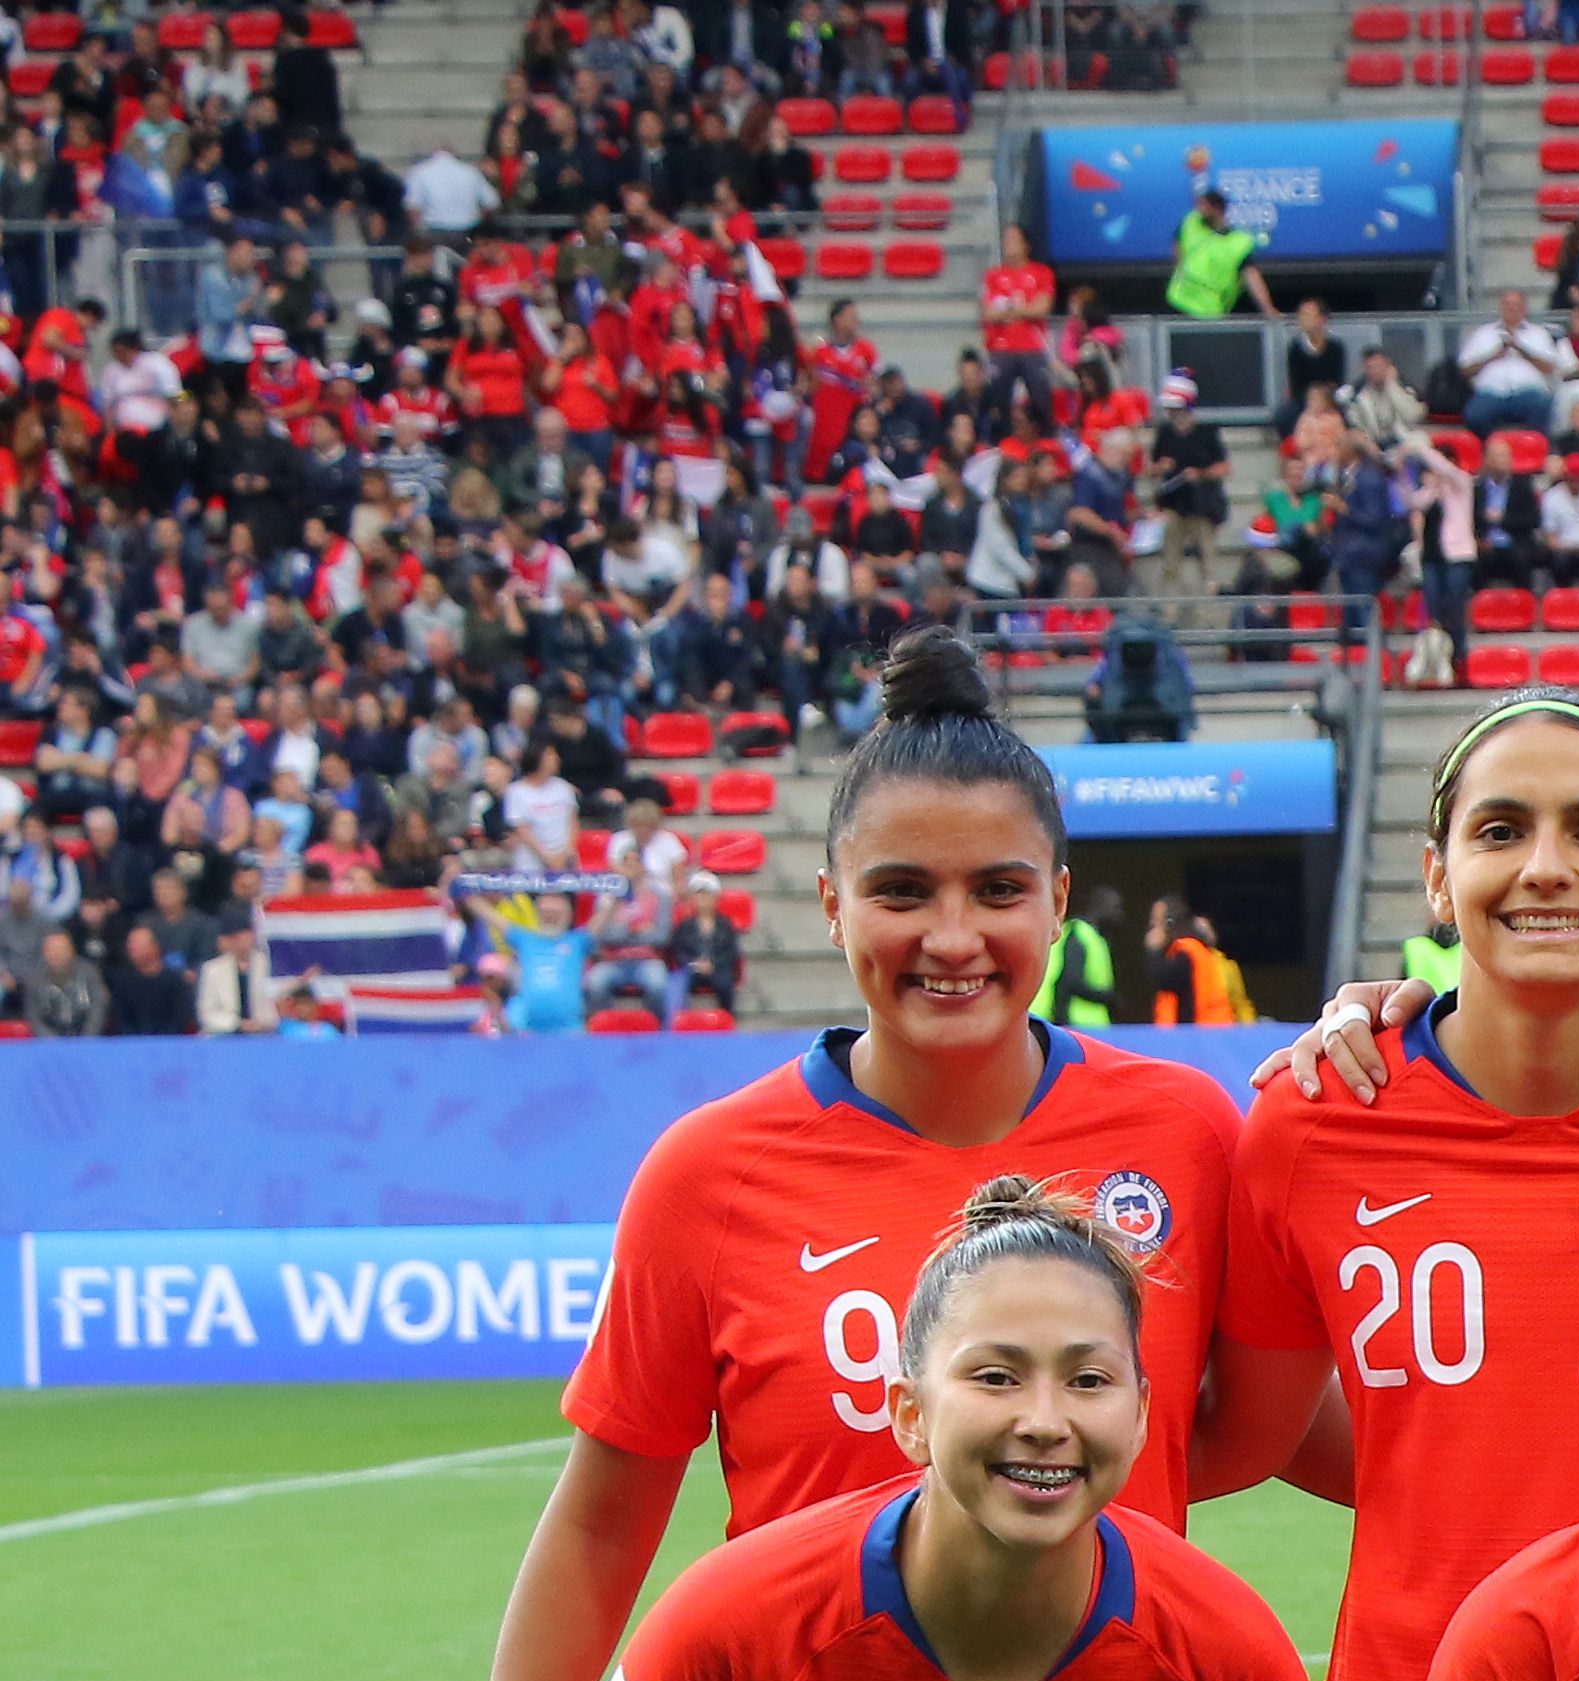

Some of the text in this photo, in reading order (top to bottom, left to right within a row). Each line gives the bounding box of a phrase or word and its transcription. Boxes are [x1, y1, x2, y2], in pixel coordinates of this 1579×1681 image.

[1074, 776, 1221, 802] #FIFAWWC
[55, 1264, 258, 1348] FIFA
[823, 1289, 904, 1432] 9
[1340, 1242, 1484, 1387] 20
